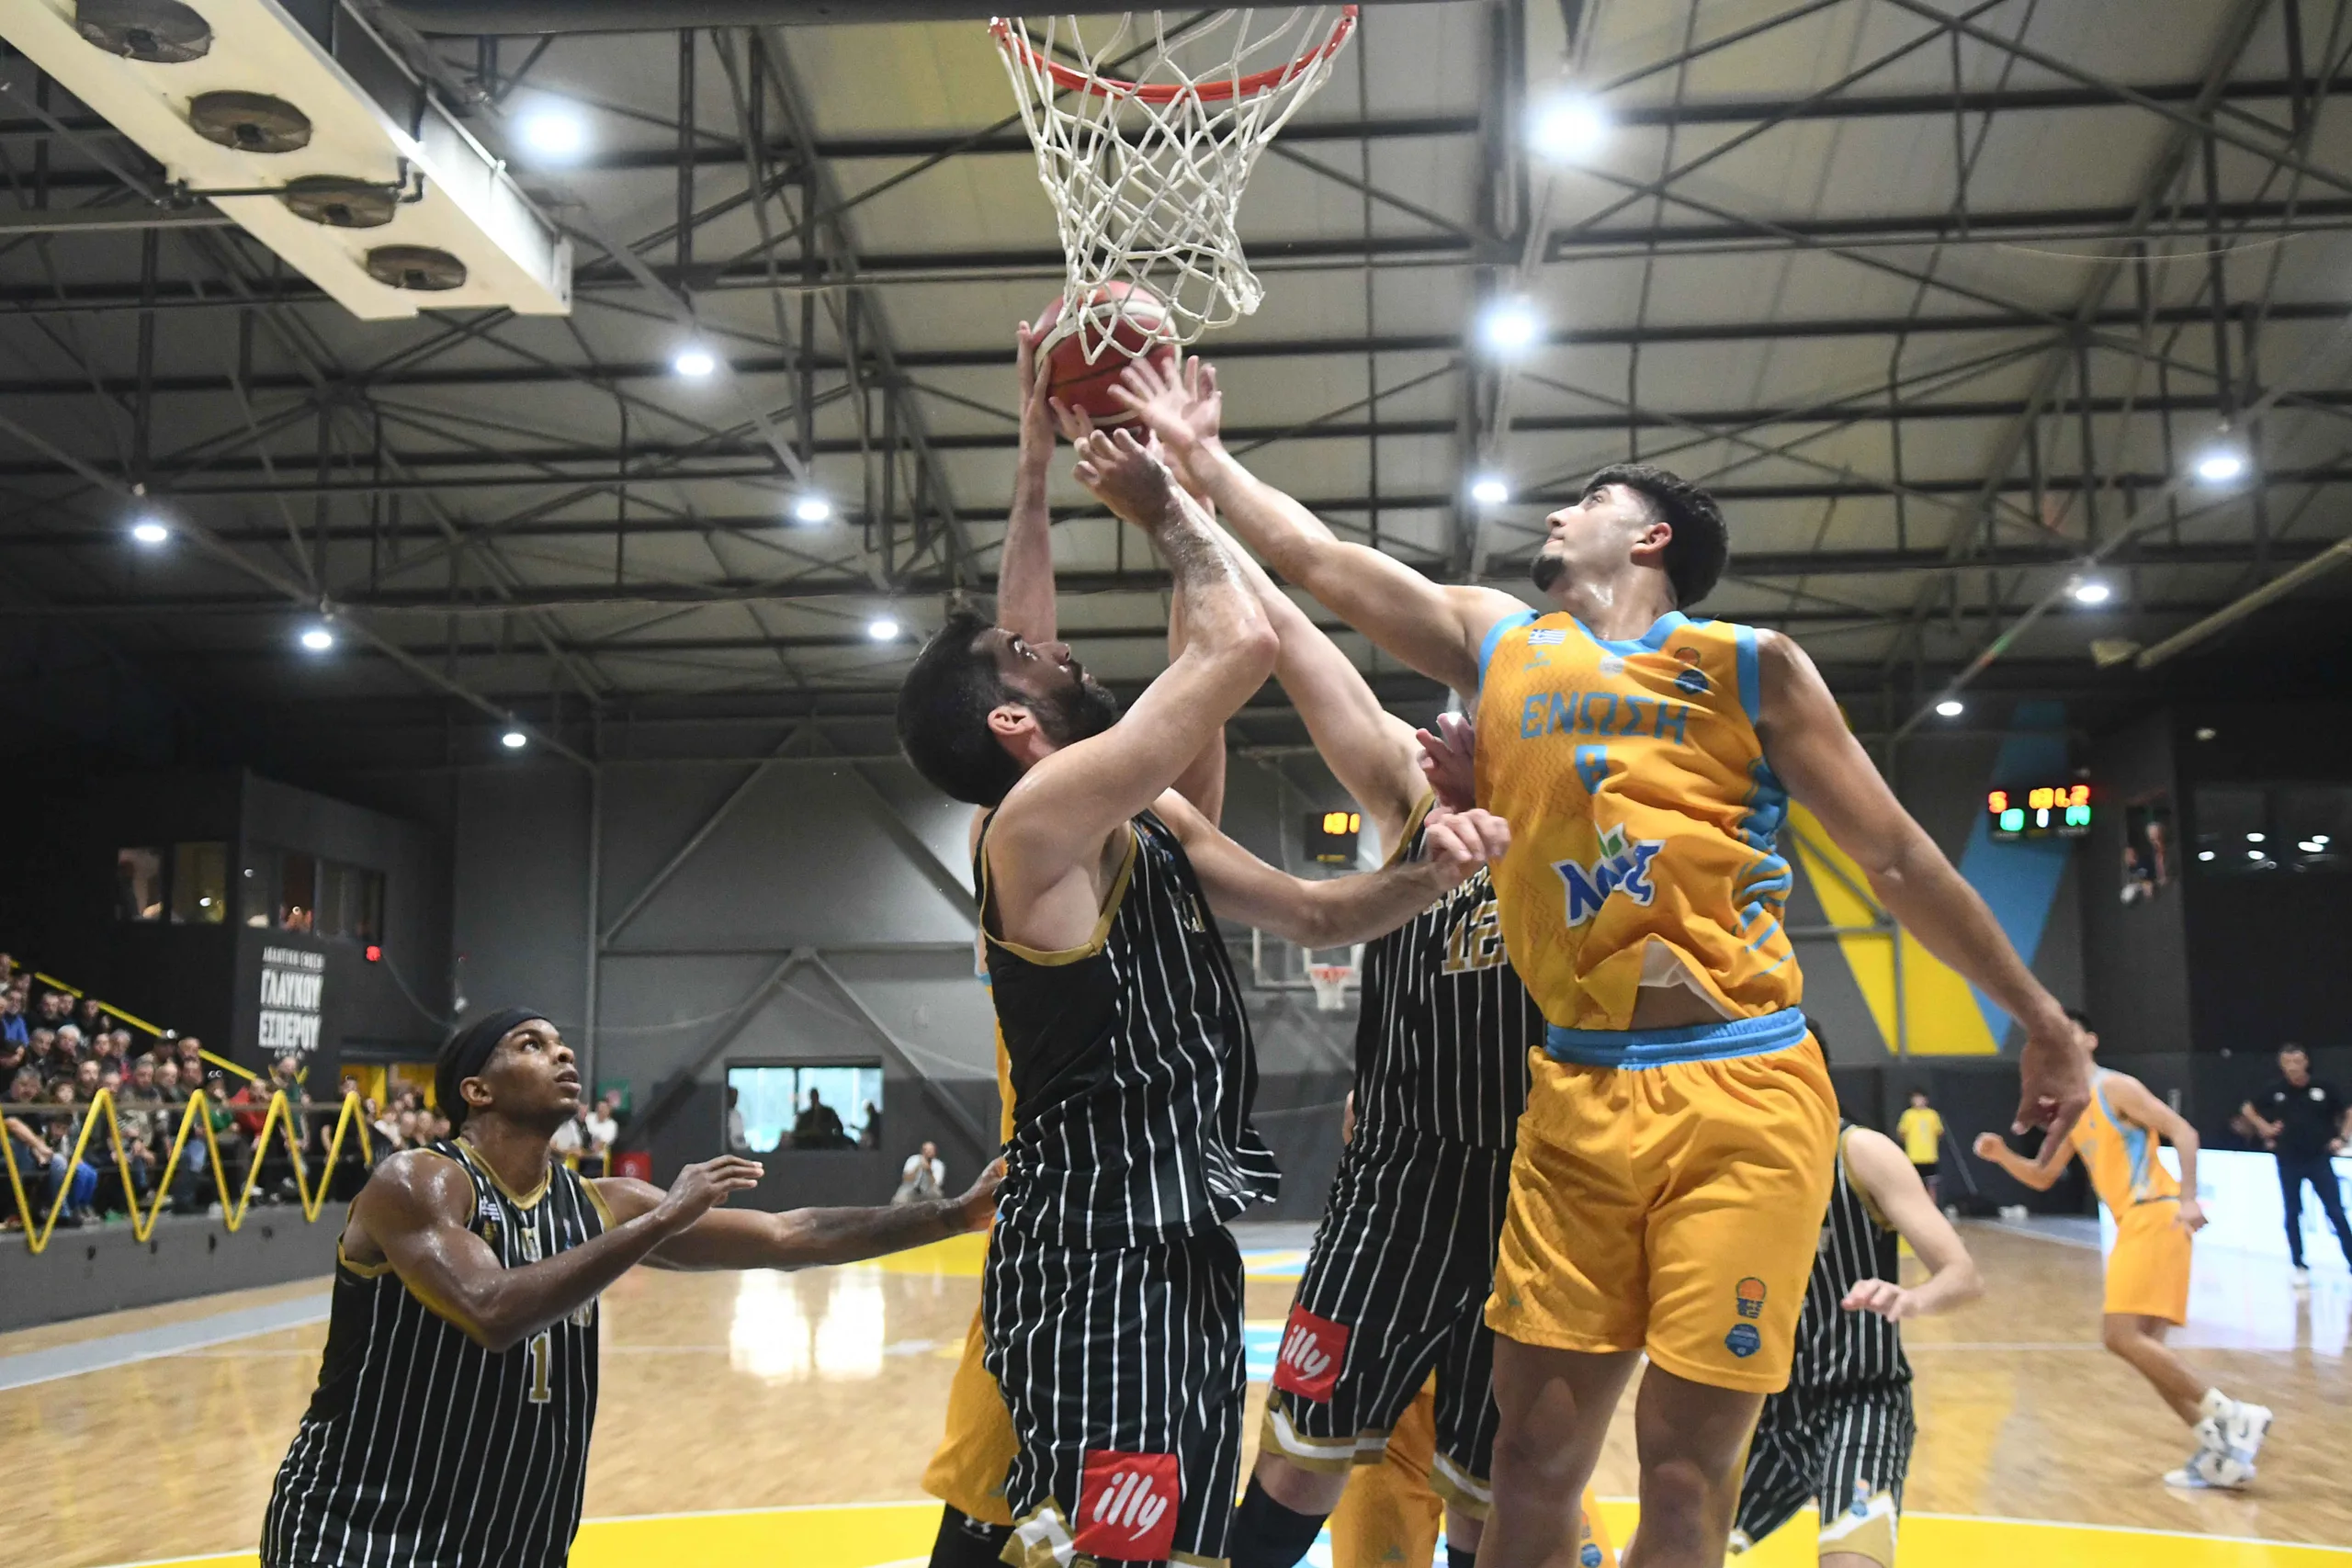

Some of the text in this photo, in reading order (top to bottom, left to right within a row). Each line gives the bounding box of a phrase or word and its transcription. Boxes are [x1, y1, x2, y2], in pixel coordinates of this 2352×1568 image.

[1521, 692, 1690, 745] ΕΝΩΣΗ
[260, 968, 324, 1010] ΓΛΑΥΚΟΥ
[258, 1010, 322, 1051] ΕΣΠΕΡΟΥ
[528, 1332, 551, 1404] 1
[1281, 1324, 1332, 1381] illy
[1092, 1471, 1169, 1542] illy
